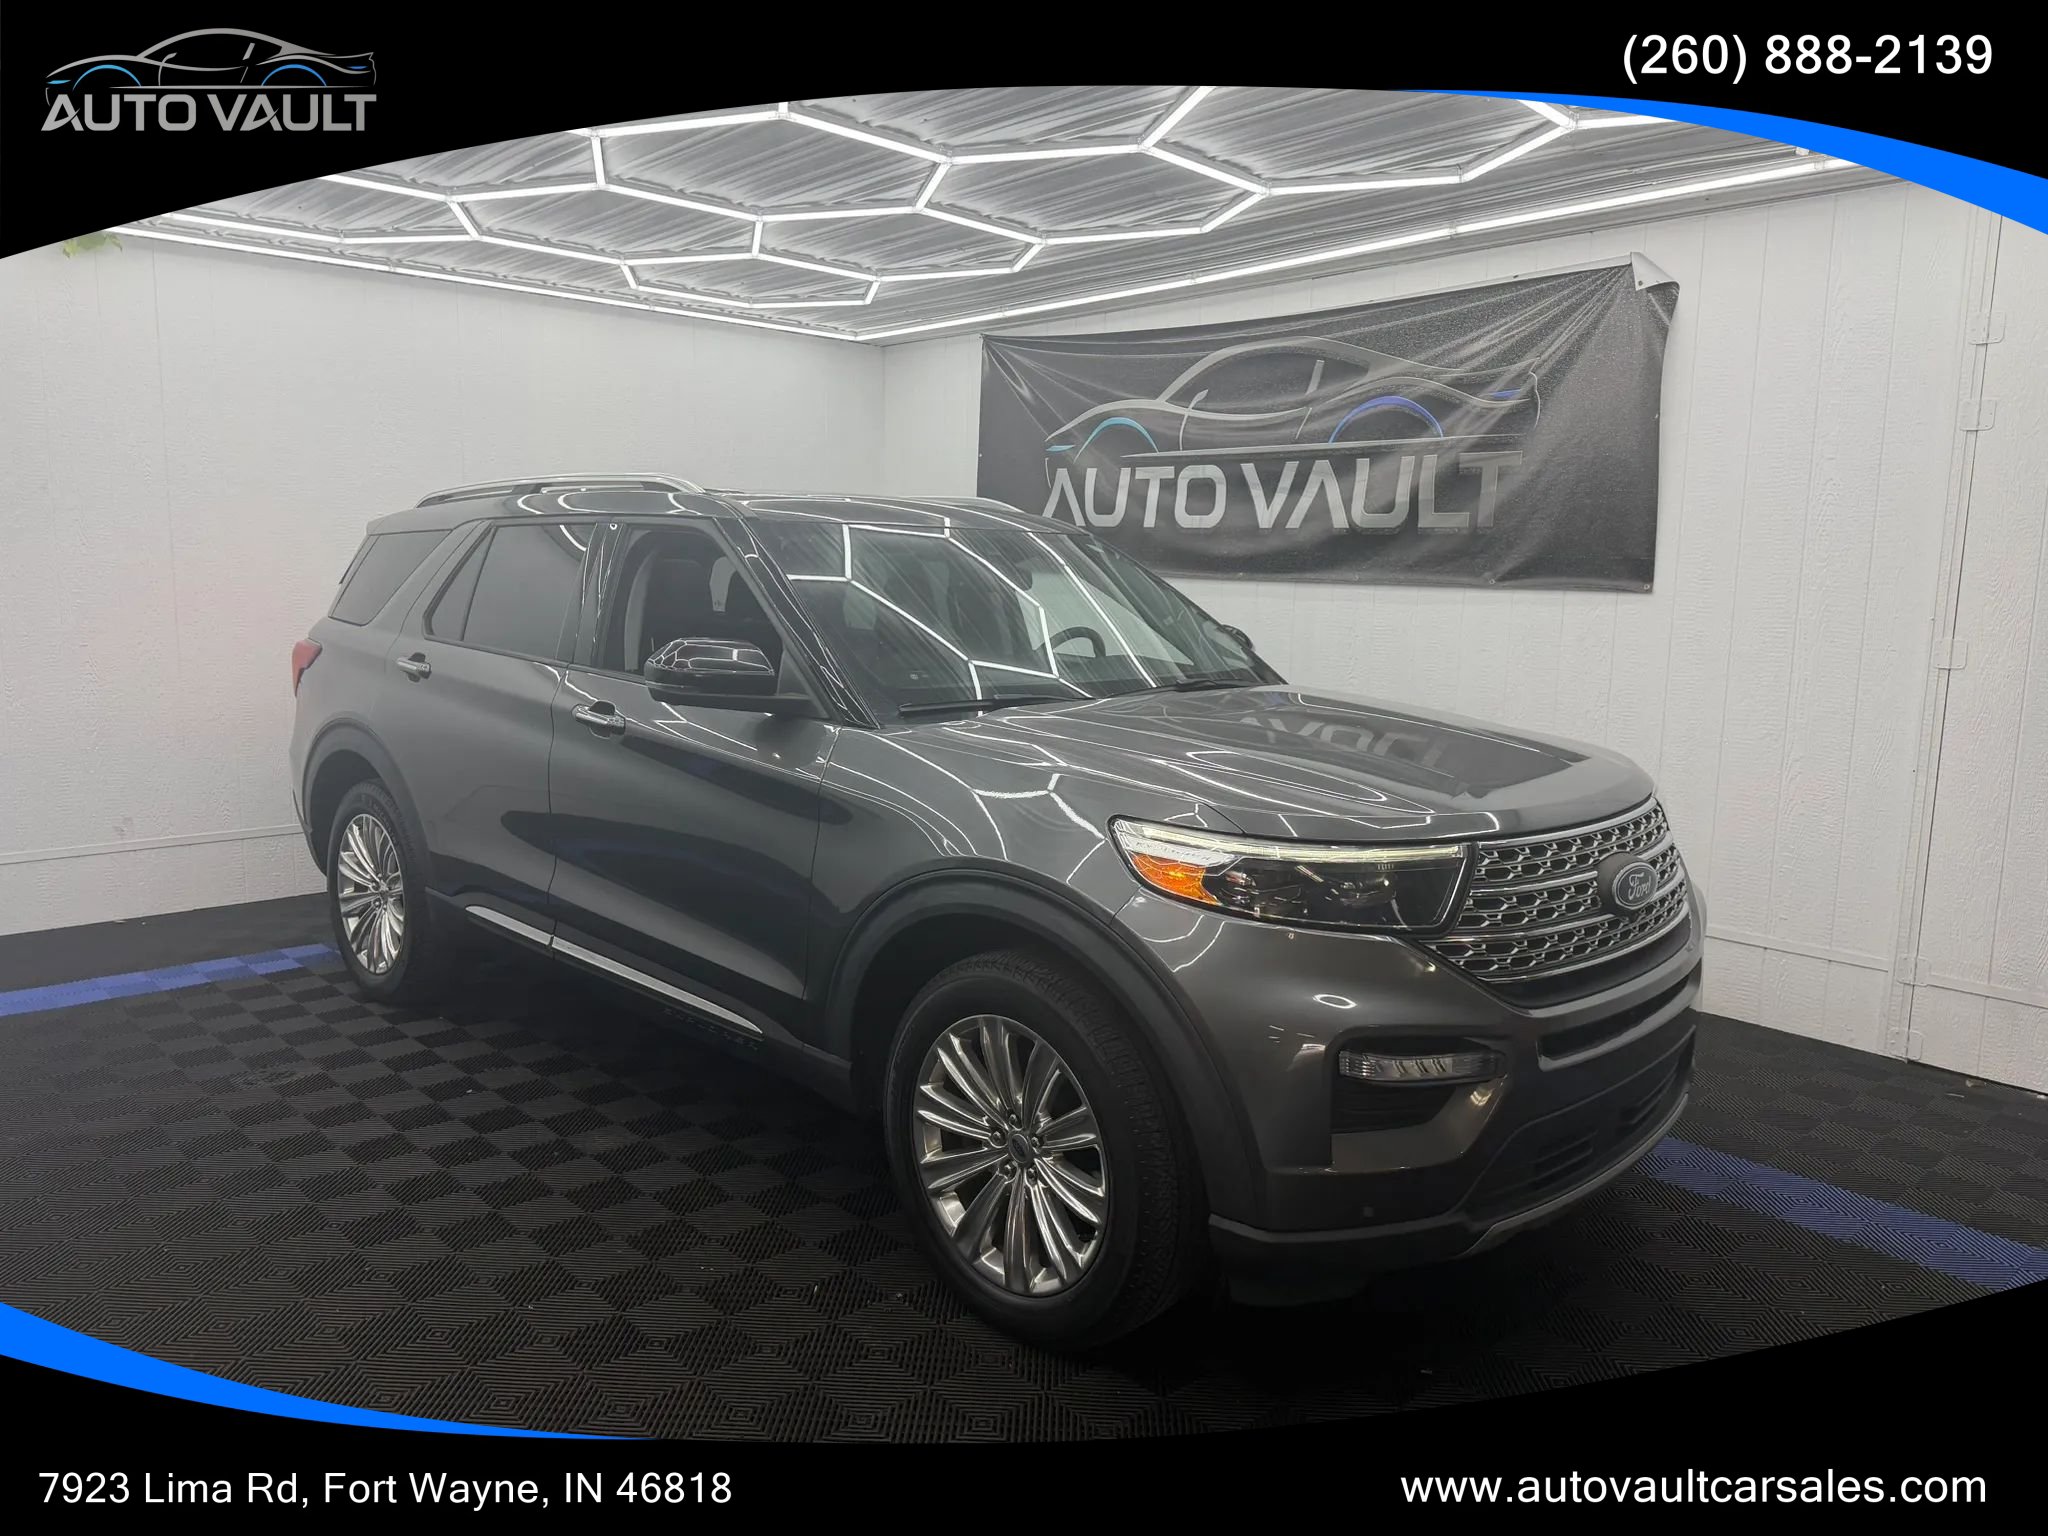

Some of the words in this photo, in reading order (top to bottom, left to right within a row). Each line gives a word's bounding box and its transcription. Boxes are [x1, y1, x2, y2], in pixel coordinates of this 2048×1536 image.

[1042, 464, 1227, 528] AUTO
[1240, 450, 1523, 530] VAULT
[1627, 872, 1652, 900] Ford
